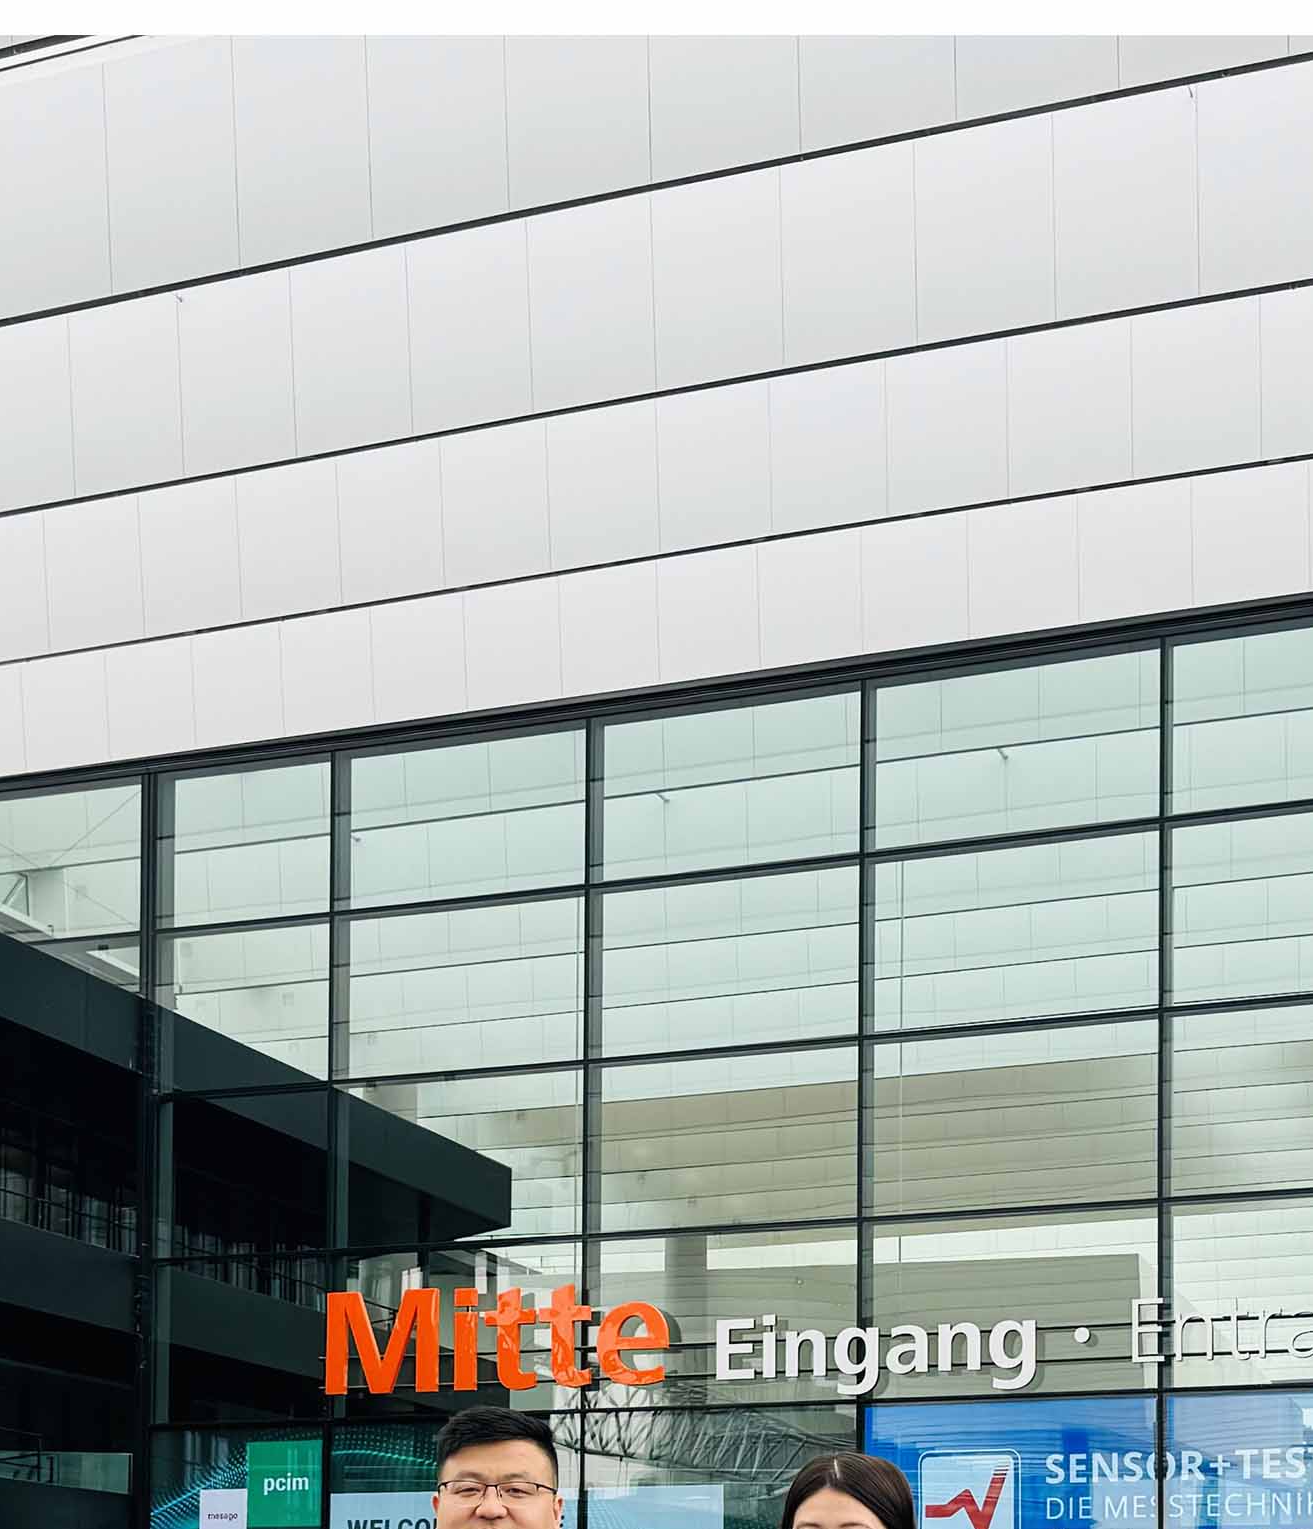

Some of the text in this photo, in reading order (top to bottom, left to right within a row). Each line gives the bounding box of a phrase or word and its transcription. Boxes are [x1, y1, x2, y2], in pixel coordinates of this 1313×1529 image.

[324, 1284, 670, 1396] Mitte
[716, 1313, 1037, 1396] Eingang
[263, 1472, 310, 1496] pcim
[1046, 1496, 1093, 1520] DIE
